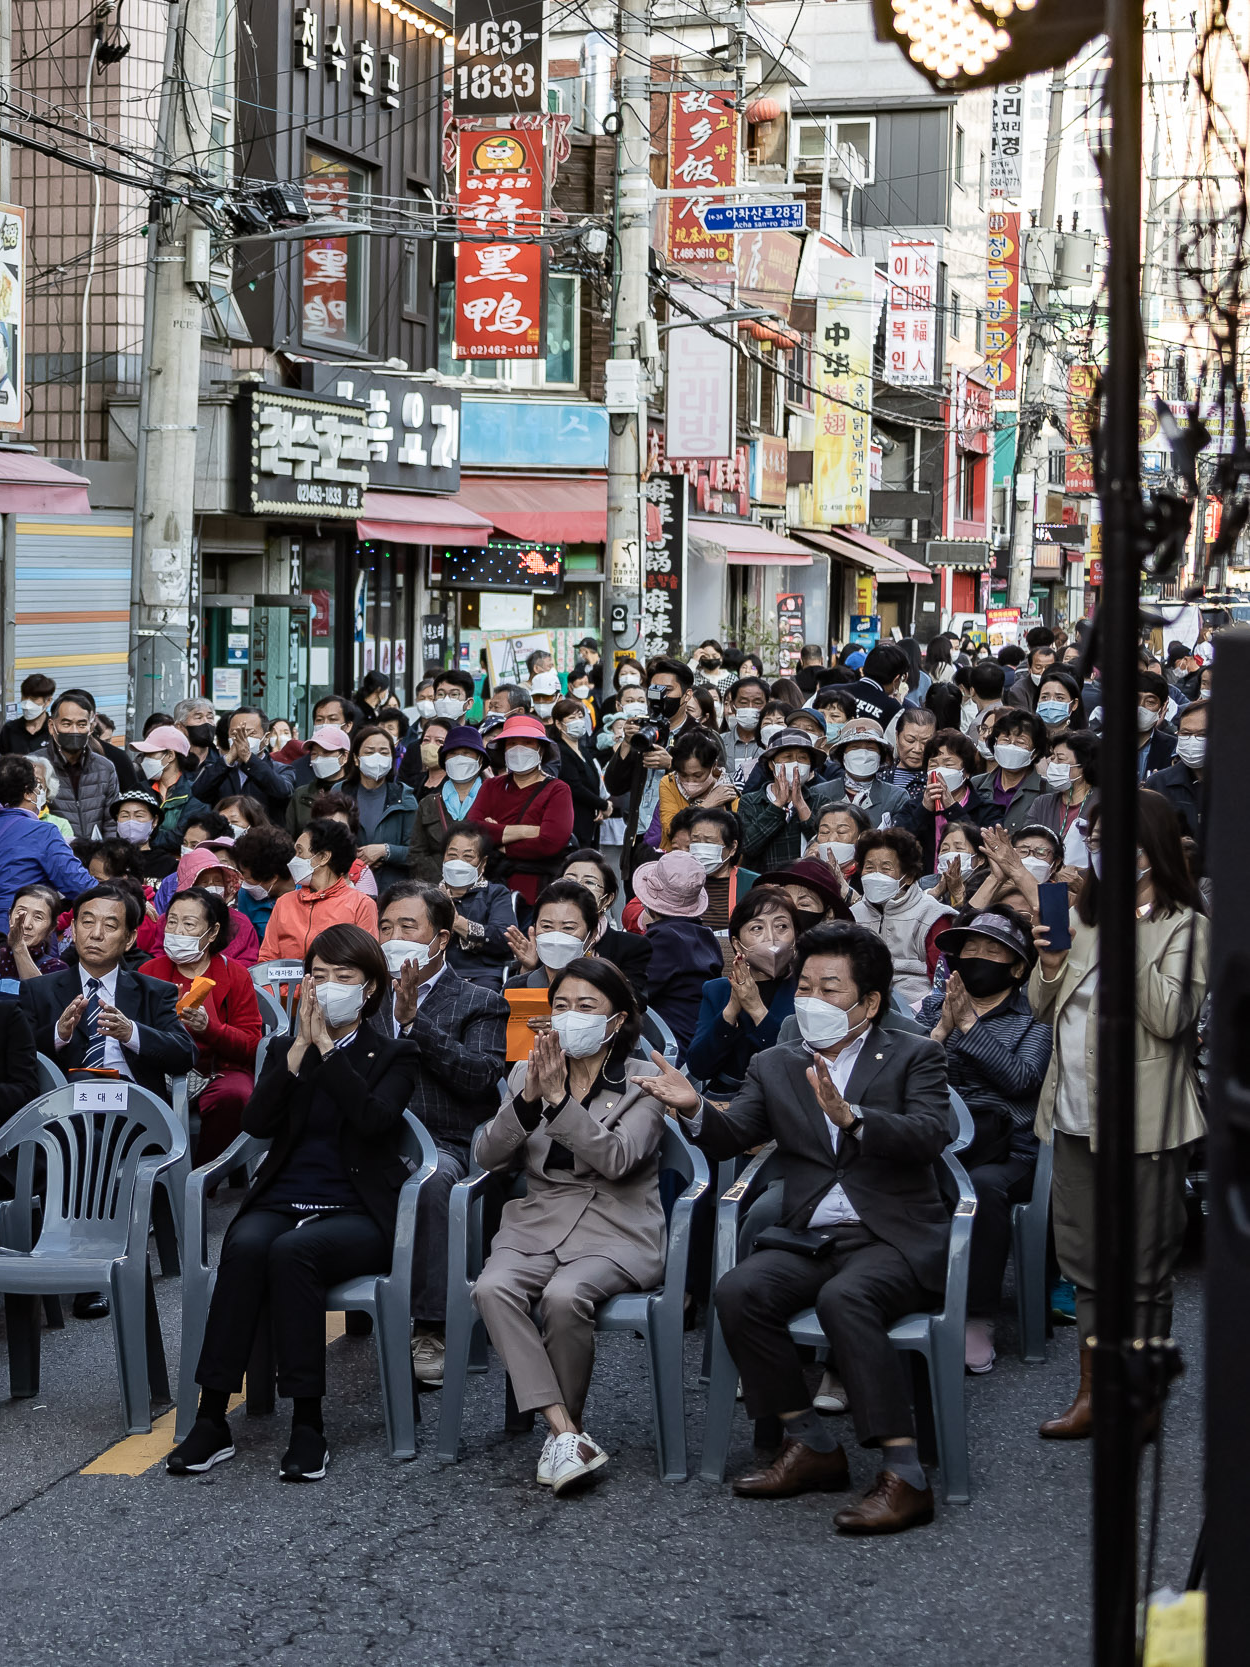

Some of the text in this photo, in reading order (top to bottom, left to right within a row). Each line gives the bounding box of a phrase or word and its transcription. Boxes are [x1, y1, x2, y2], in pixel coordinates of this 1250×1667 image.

[457, 20, 539, 56] 463-
[300, 7, 400, 109] 천수호프
[457, 63, 534, 99] 1833
[725, 206, 802, 220] 아차산로28길
[677, 337, 722, 453] 노래방
[259, 406, 370, 483] 천수호프
[856, 699, 883, 718] KUK
